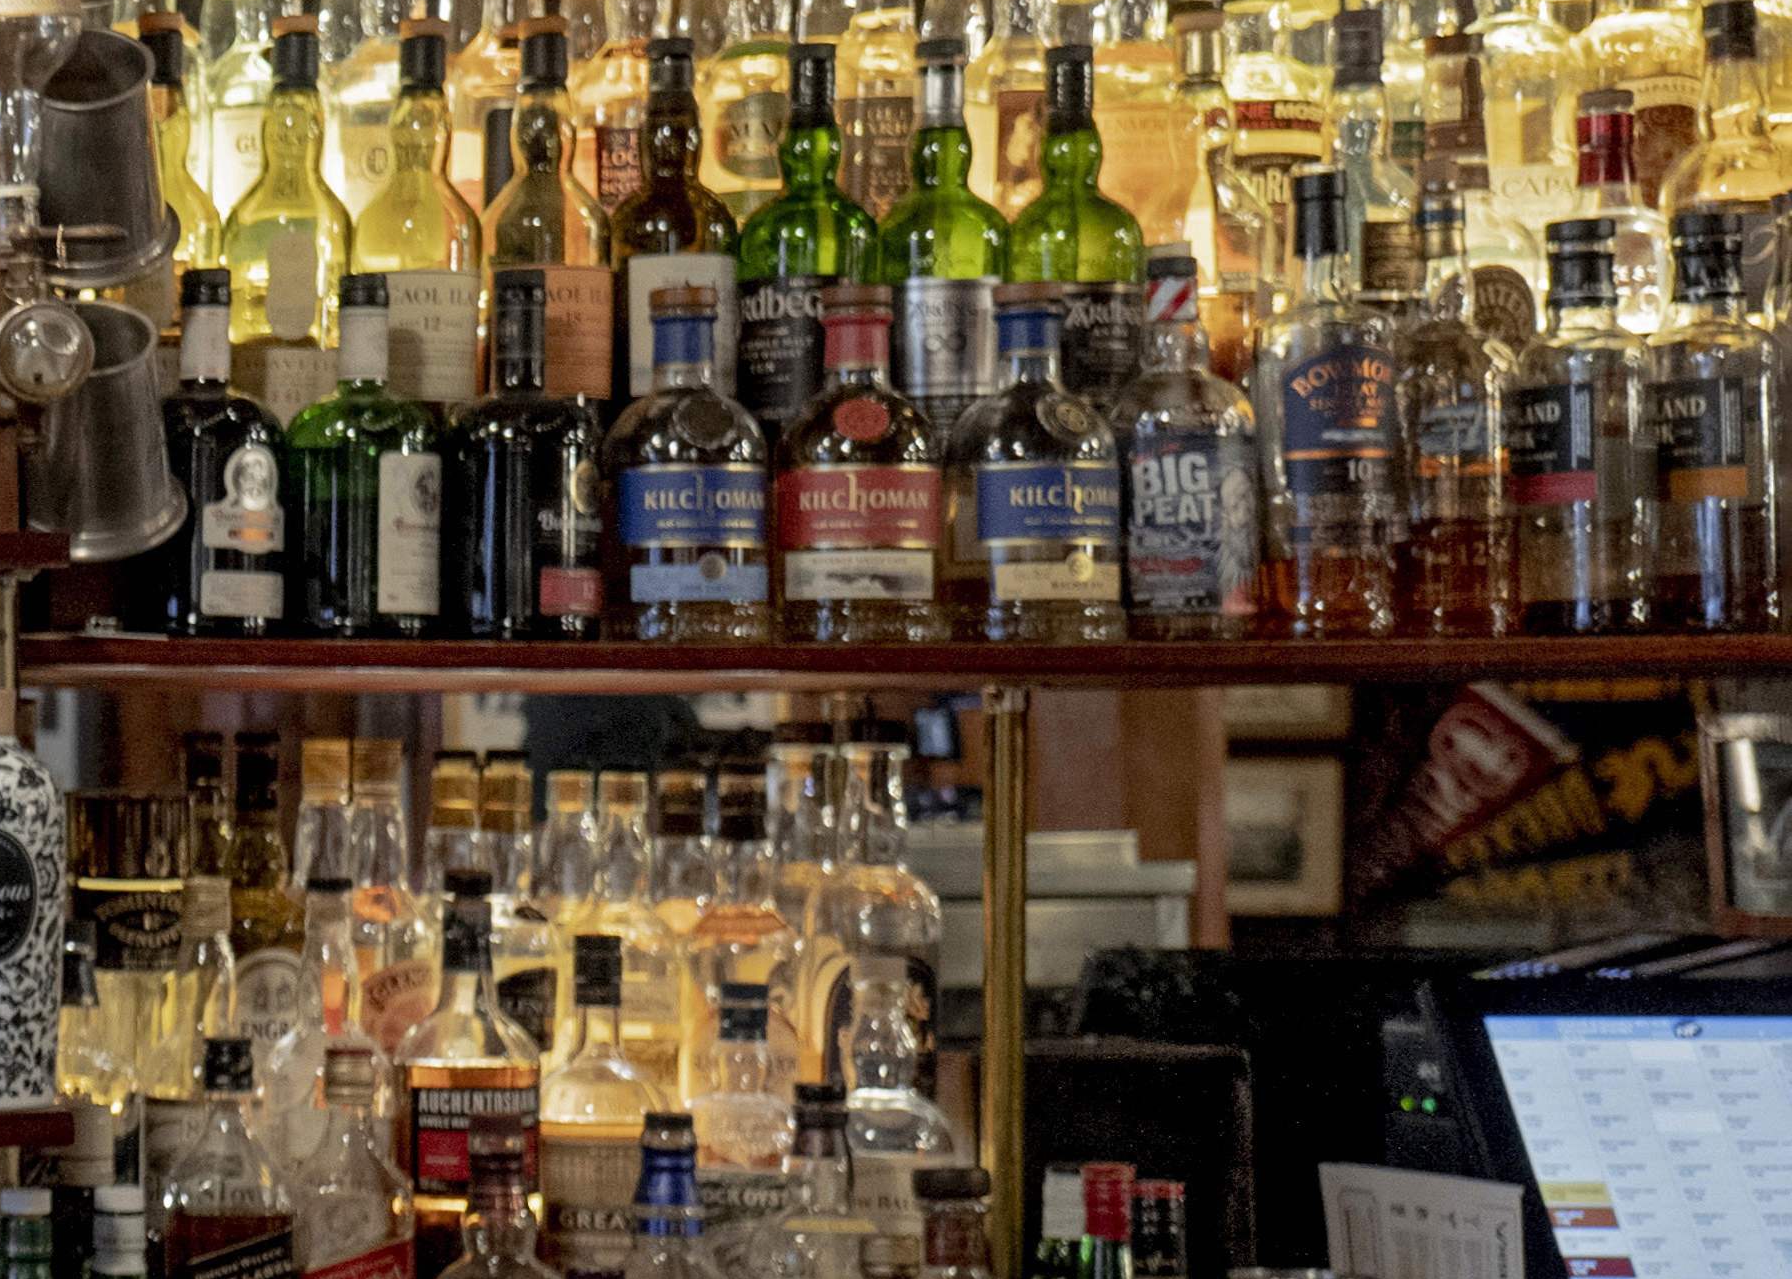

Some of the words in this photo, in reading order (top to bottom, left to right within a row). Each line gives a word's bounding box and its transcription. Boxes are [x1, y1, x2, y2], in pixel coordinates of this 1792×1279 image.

[1131, 454, 1210, 493] BIG
[1347, 458, 1374, 482] 10
[1133, 493, 1218, 528] PEAT
